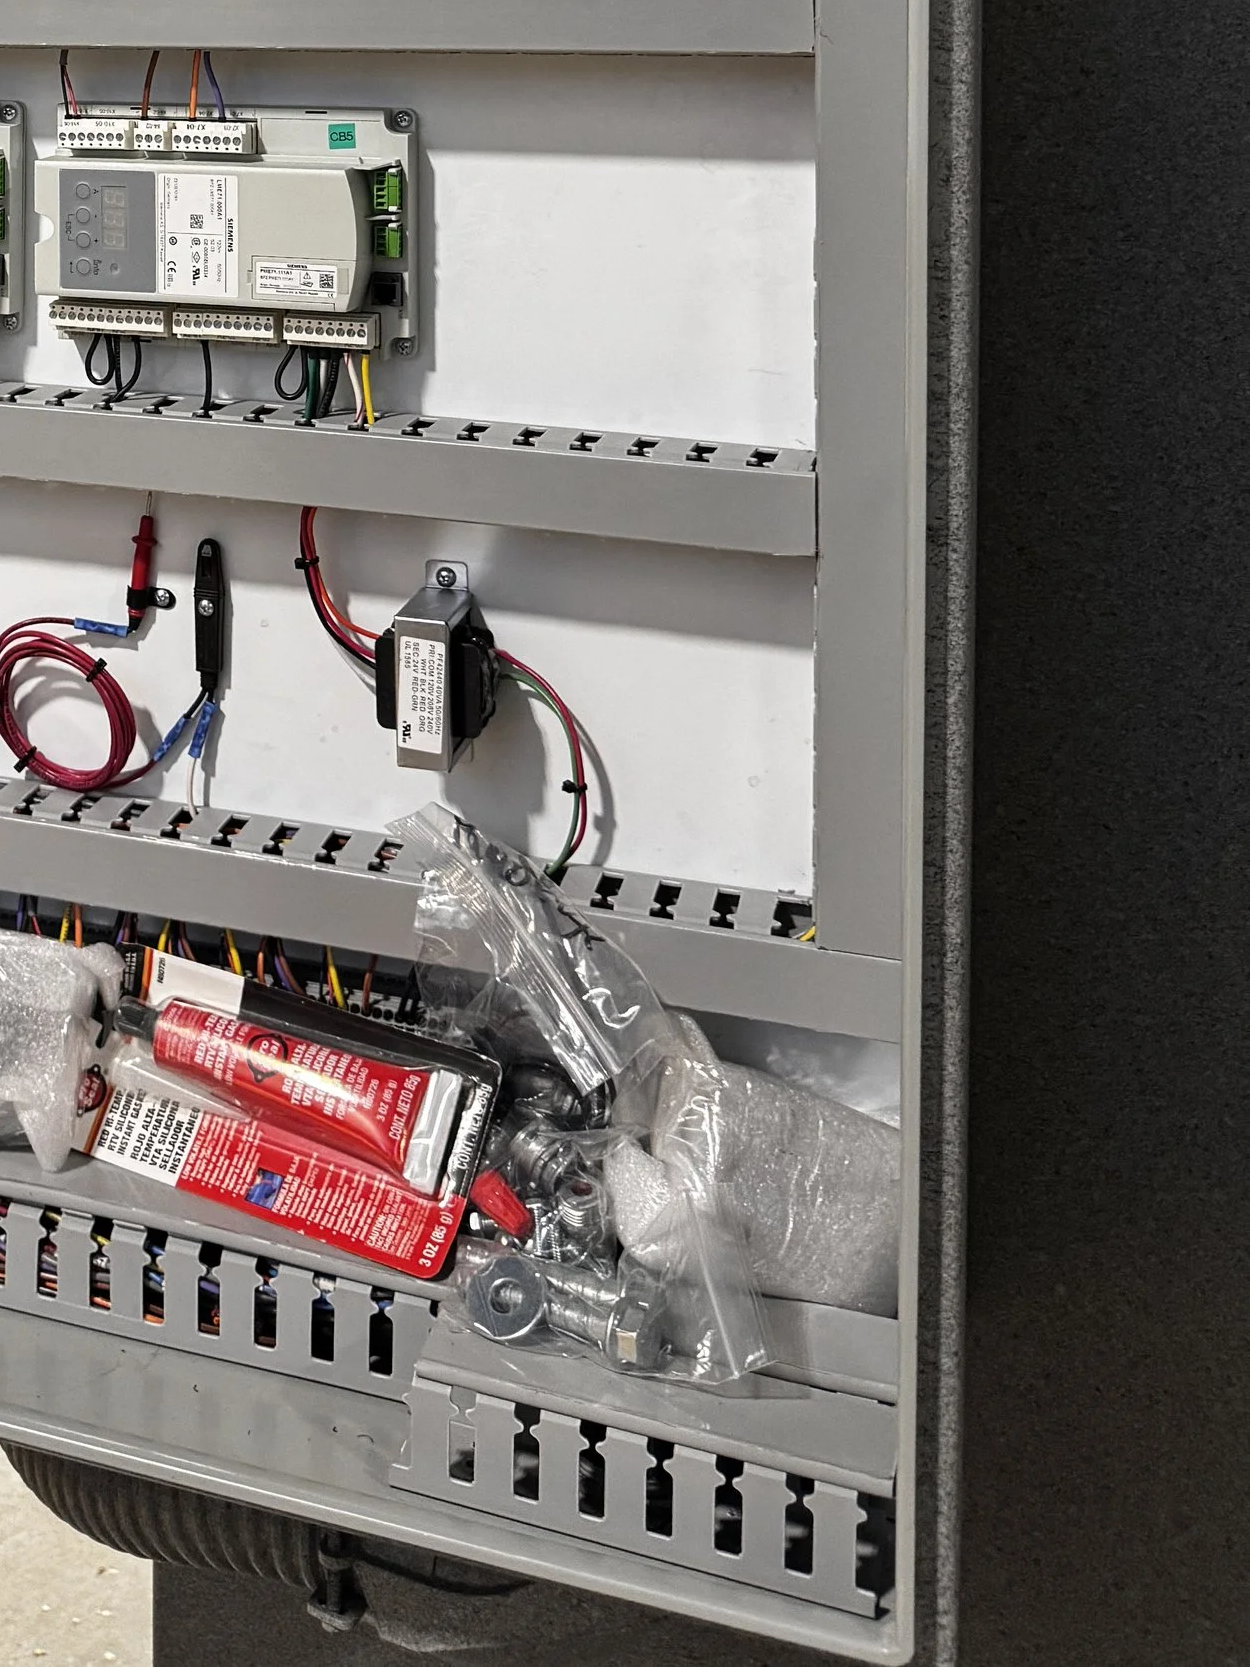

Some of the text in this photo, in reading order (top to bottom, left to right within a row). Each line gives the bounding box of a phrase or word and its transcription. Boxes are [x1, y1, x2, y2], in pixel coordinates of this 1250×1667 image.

[329, 130, 354, 142] CB5
[405, 641, 411, 650] UL
[84, 1076, 100, 1107] Seal
[404, 1075, 421, 1093] 85g
[397, 1091, 415, 1120] NETO
[98, 1129, 110, 1147] RED
[108, 1133, 119, 1151] RTV
[117, 1121, 136, 1155] INSTANT
[130, 1103, 157, 1159] ROJO ALTA-
[149, 1100, 180, 1166] VTA SILICONA
[159, 1120, 184, 1170] SELLADOR
[168, 1107, 200, 1174] INSTANTANEO
[456, 1141, 475, 1170] CONT.
[418, 1211, 454, 1267] 3 OZ (85 g)
